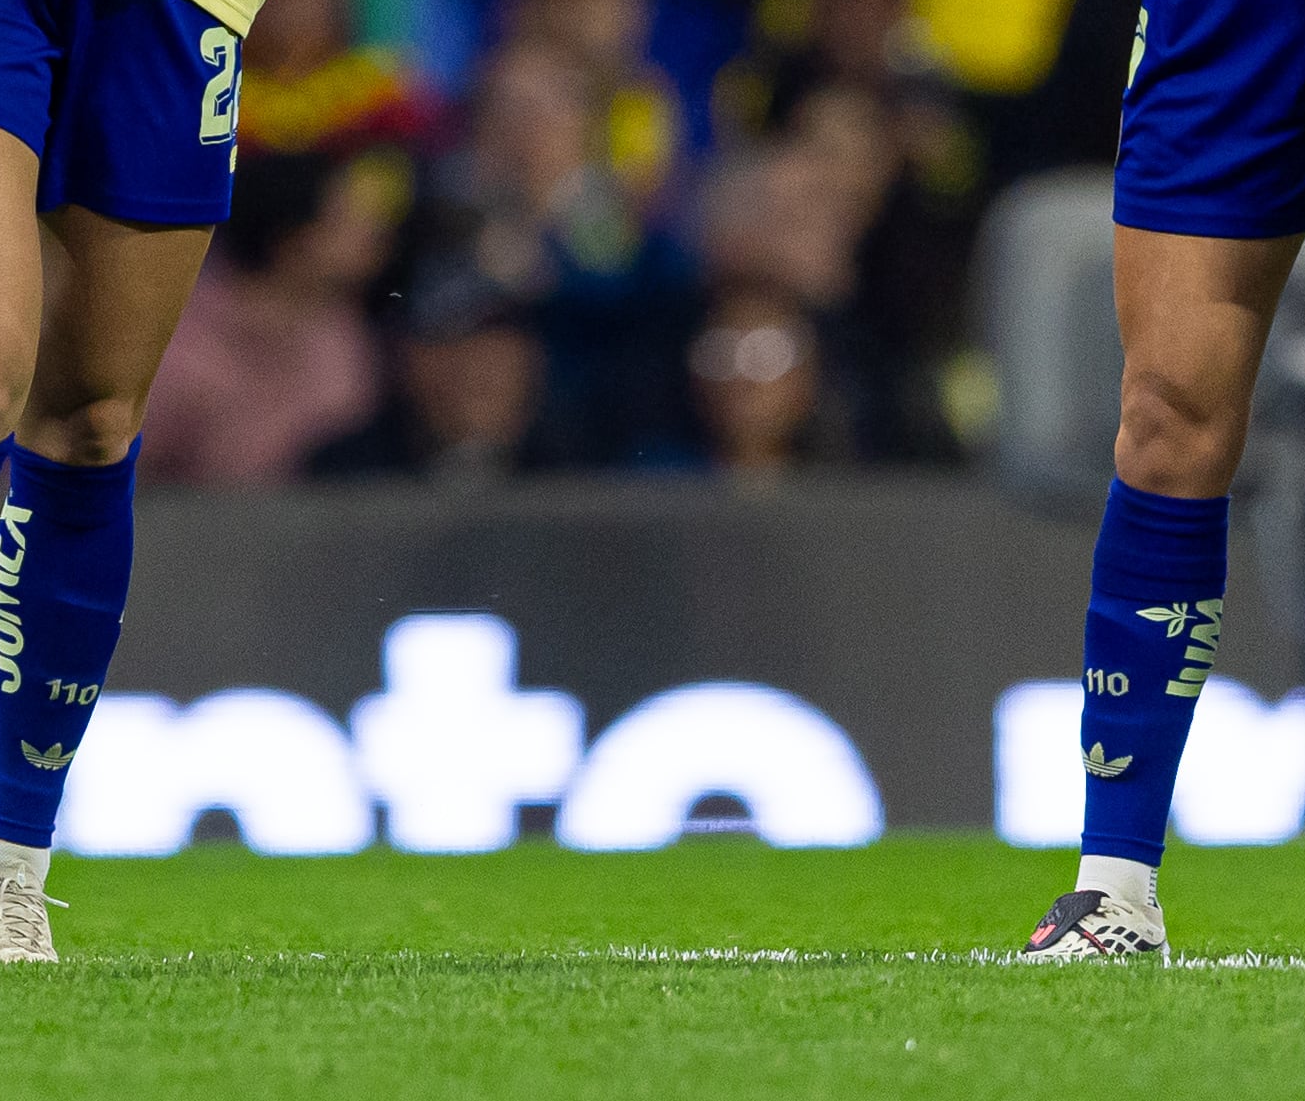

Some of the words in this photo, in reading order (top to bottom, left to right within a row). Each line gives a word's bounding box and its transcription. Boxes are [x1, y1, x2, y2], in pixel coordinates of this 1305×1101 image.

[199, 26, 243, 145] 2
[46, 679, 100, 706] 110
[1086, 668, 1129, 696] 110
